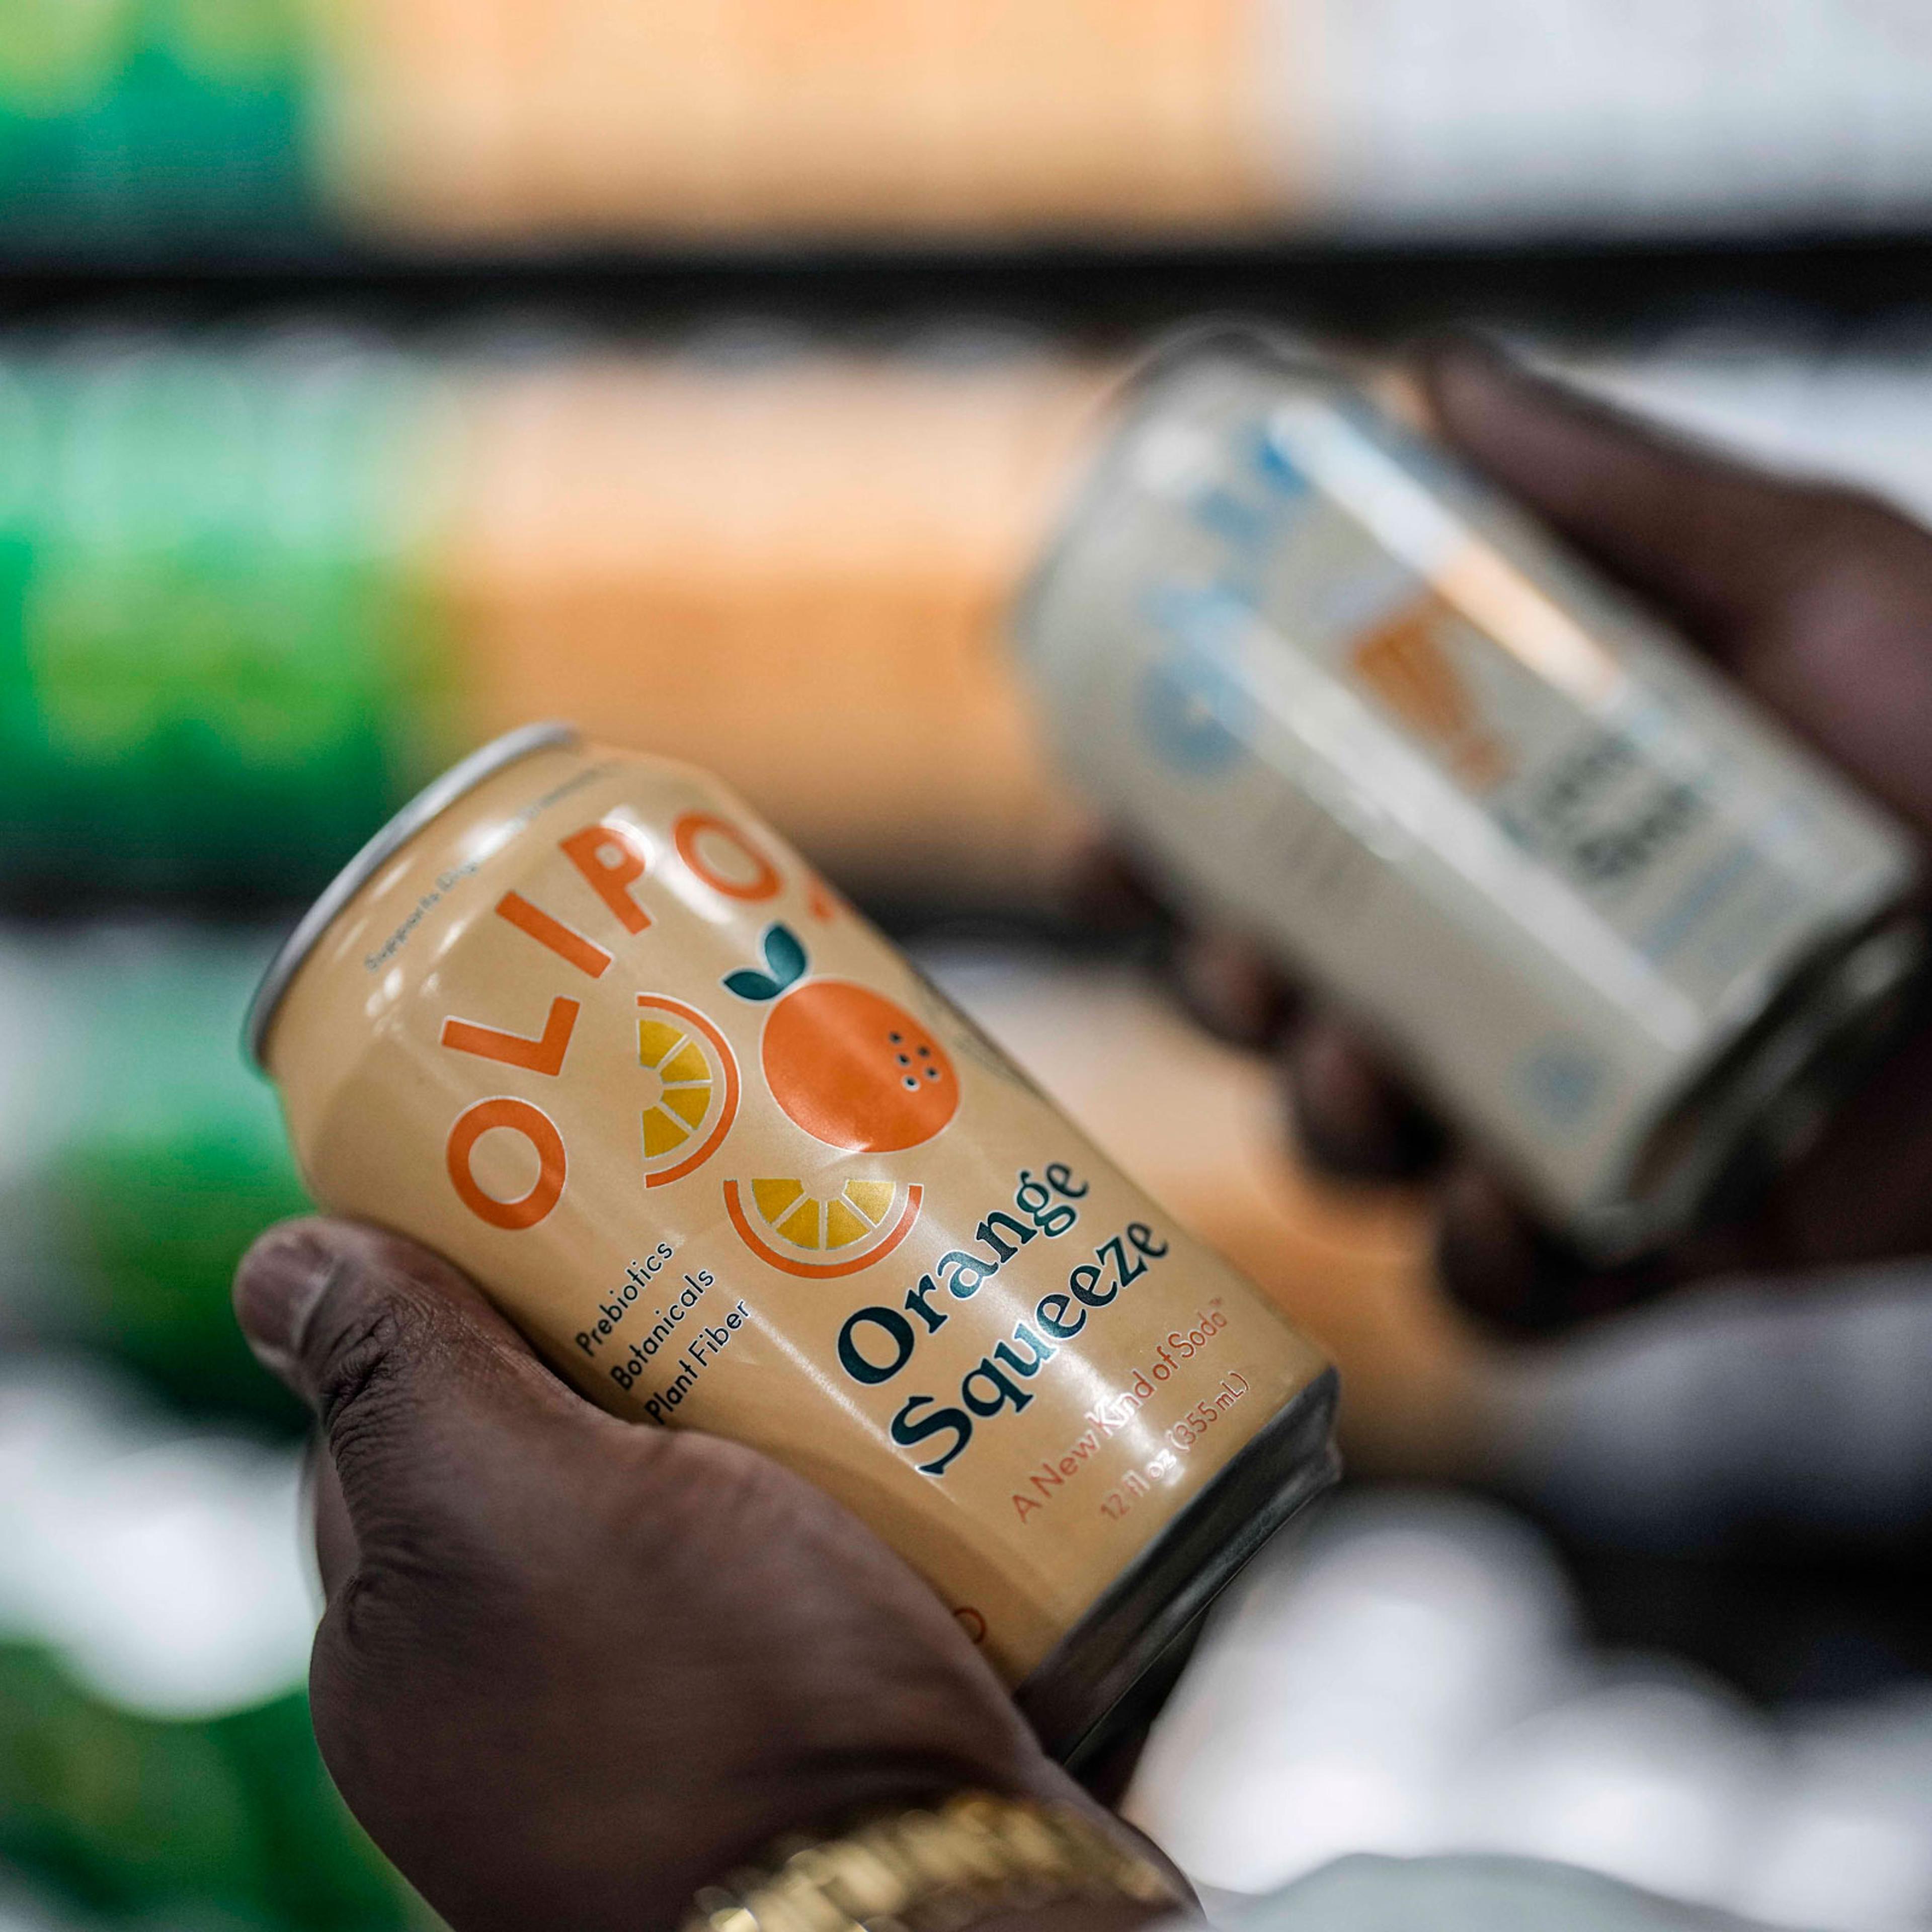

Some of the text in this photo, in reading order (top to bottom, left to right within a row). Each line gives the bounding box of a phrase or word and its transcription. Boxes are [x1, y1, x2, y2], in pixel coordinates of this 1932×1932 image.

[575, 1242, 674, 1358] Prebiotics
[609, 1268, 715, 1391] Botanicals
[838, 1162, 1089, 1385] Orange
[643, 1299, 753, 1425] Plant Fiber
[891, 1222, 1169, 1476] Squeeze
[1012, 1494, 1043, 1524] A
[1029, 1430, 1100, 1499] New
[1152, 1345, 1179, 1381] of
[1100, 1493, 1130, 1520] 12
[1122, 1470, 1150, 1498] fl
[1166, 1401, 1218, 1452] (355
[1215, 1371, 1250, 1411] mL)
